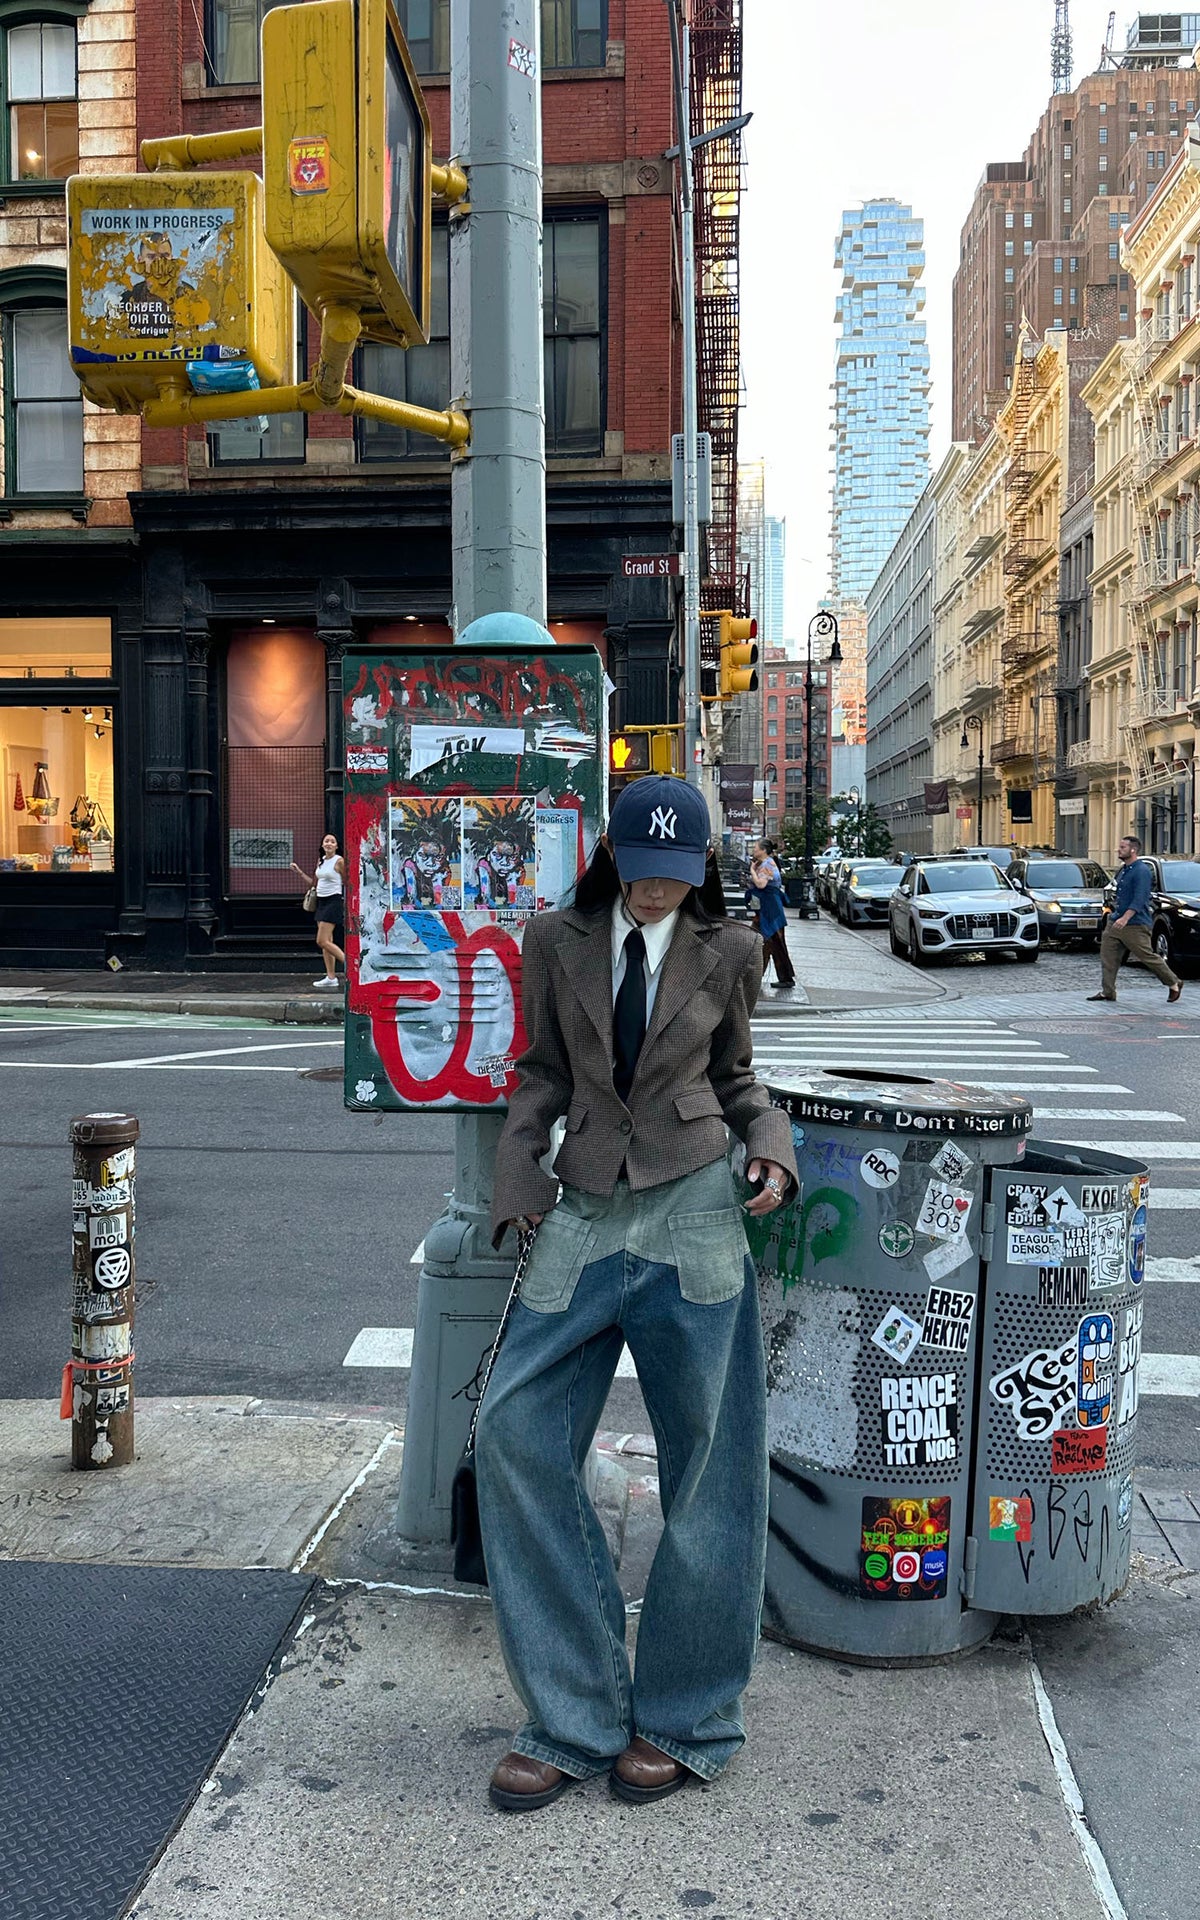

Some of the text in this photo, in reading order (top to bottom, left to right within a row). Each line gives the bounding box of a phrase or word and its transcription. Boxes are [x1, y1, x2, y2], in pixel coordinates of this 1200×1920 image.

[293, 146, 325, 160] TIZZ
[92, 216, 223, 229] WORK IN PROGRESS
[625, 559, 670, 575] Grand St
[648, 805, 678, 839] NY
[58, 854, 90, 864] MoMA
[896, 1111, 955, 1131] Don't
[864, 1153, 898, 1184] RDC
[928, 1188, 954, 1210] YO
[1007, 1184, 1047, 1199] CRAZY
[922, 1207, 962, 1233] 305
[1007, 1212, 1044, 1226] EDDIE
[1012, 1234, 1054, 1244] TEAGUE
[1066, 1237, 1089, 1248] WAS
[1012, 1244, 1050, 1254] DENSO
[1066, 1246, 1090, 1258] HERE
[1038, 1267, 1088, 1305] REMAND
[927, 1288, 974, 1320] ER52
[921, 1315, 970, 1350] HEKTIC
[880, 1372, 956, 1410] RENCE
[887, 1406, 950, 1443] COAL
[884, 1438, 956, 1466] TKT NOG
[863, 1529, 948, 1546] TEN SPHERES
[924, 1560, 944, 1570] music
